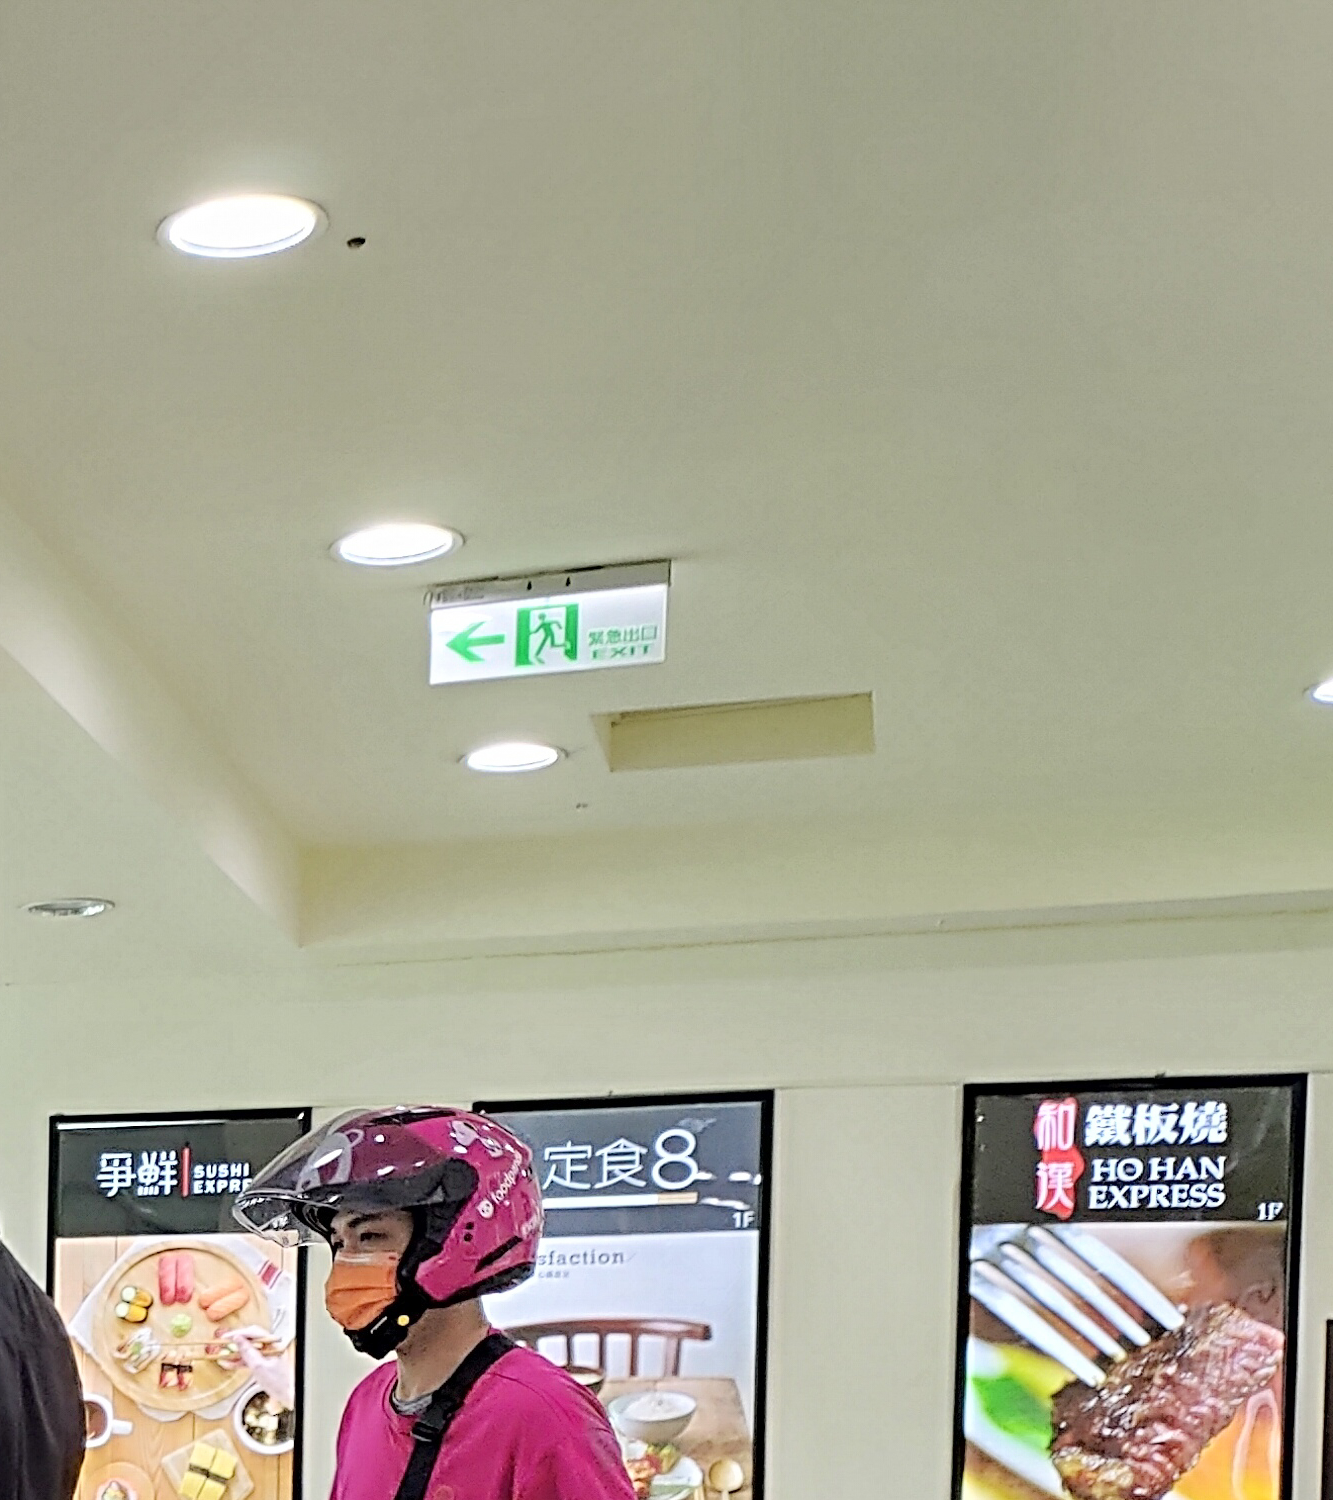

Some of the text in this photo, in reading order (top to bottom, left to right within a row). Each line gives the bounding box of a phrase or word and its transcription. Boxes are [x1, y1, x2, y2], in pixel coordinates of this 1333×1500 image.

[592, 643, 653, 659] EXIT
[1084, 1101, 1228, 1147] 鐵板燒
[193, 1162, 250, 1179] SUSHI
[542, 1128, 698, 1191] 定食8
[1091, 1156, 1227, 1183] HO HAN
[96, 1150, 179, 1198] 爭鮮
[1088, 1183, 1227, 1210] EXPRESS
[732, 1211, 755, 1229] 1F
[1257, 1203, 1283, 1221] 1F
